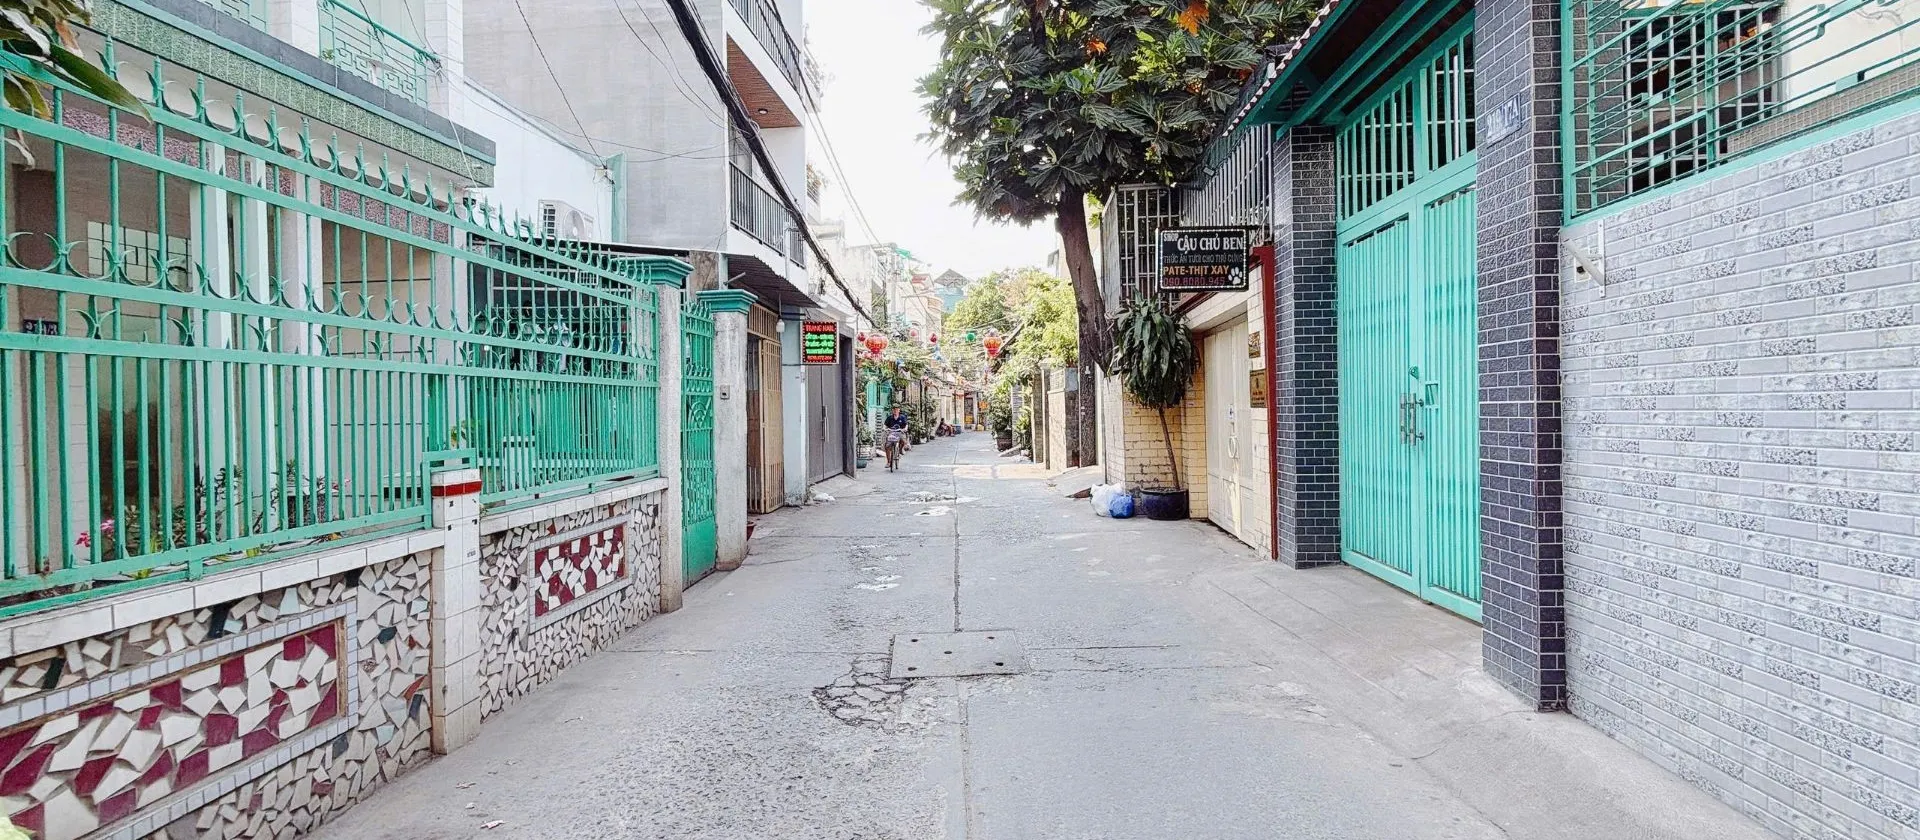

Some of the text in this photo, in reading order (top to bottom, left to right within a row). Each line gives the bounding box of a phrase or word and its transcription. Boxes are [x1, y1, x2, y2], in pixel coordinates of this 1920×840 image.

[1164, 233, 1179, 242] SHOP
[1177, 233, 1243, 255] CẬU CHỦ BEN
[1202, 255, 1214, 263] CHO
[1163, 266, 1229, 276] PATE-THỊT XAY
